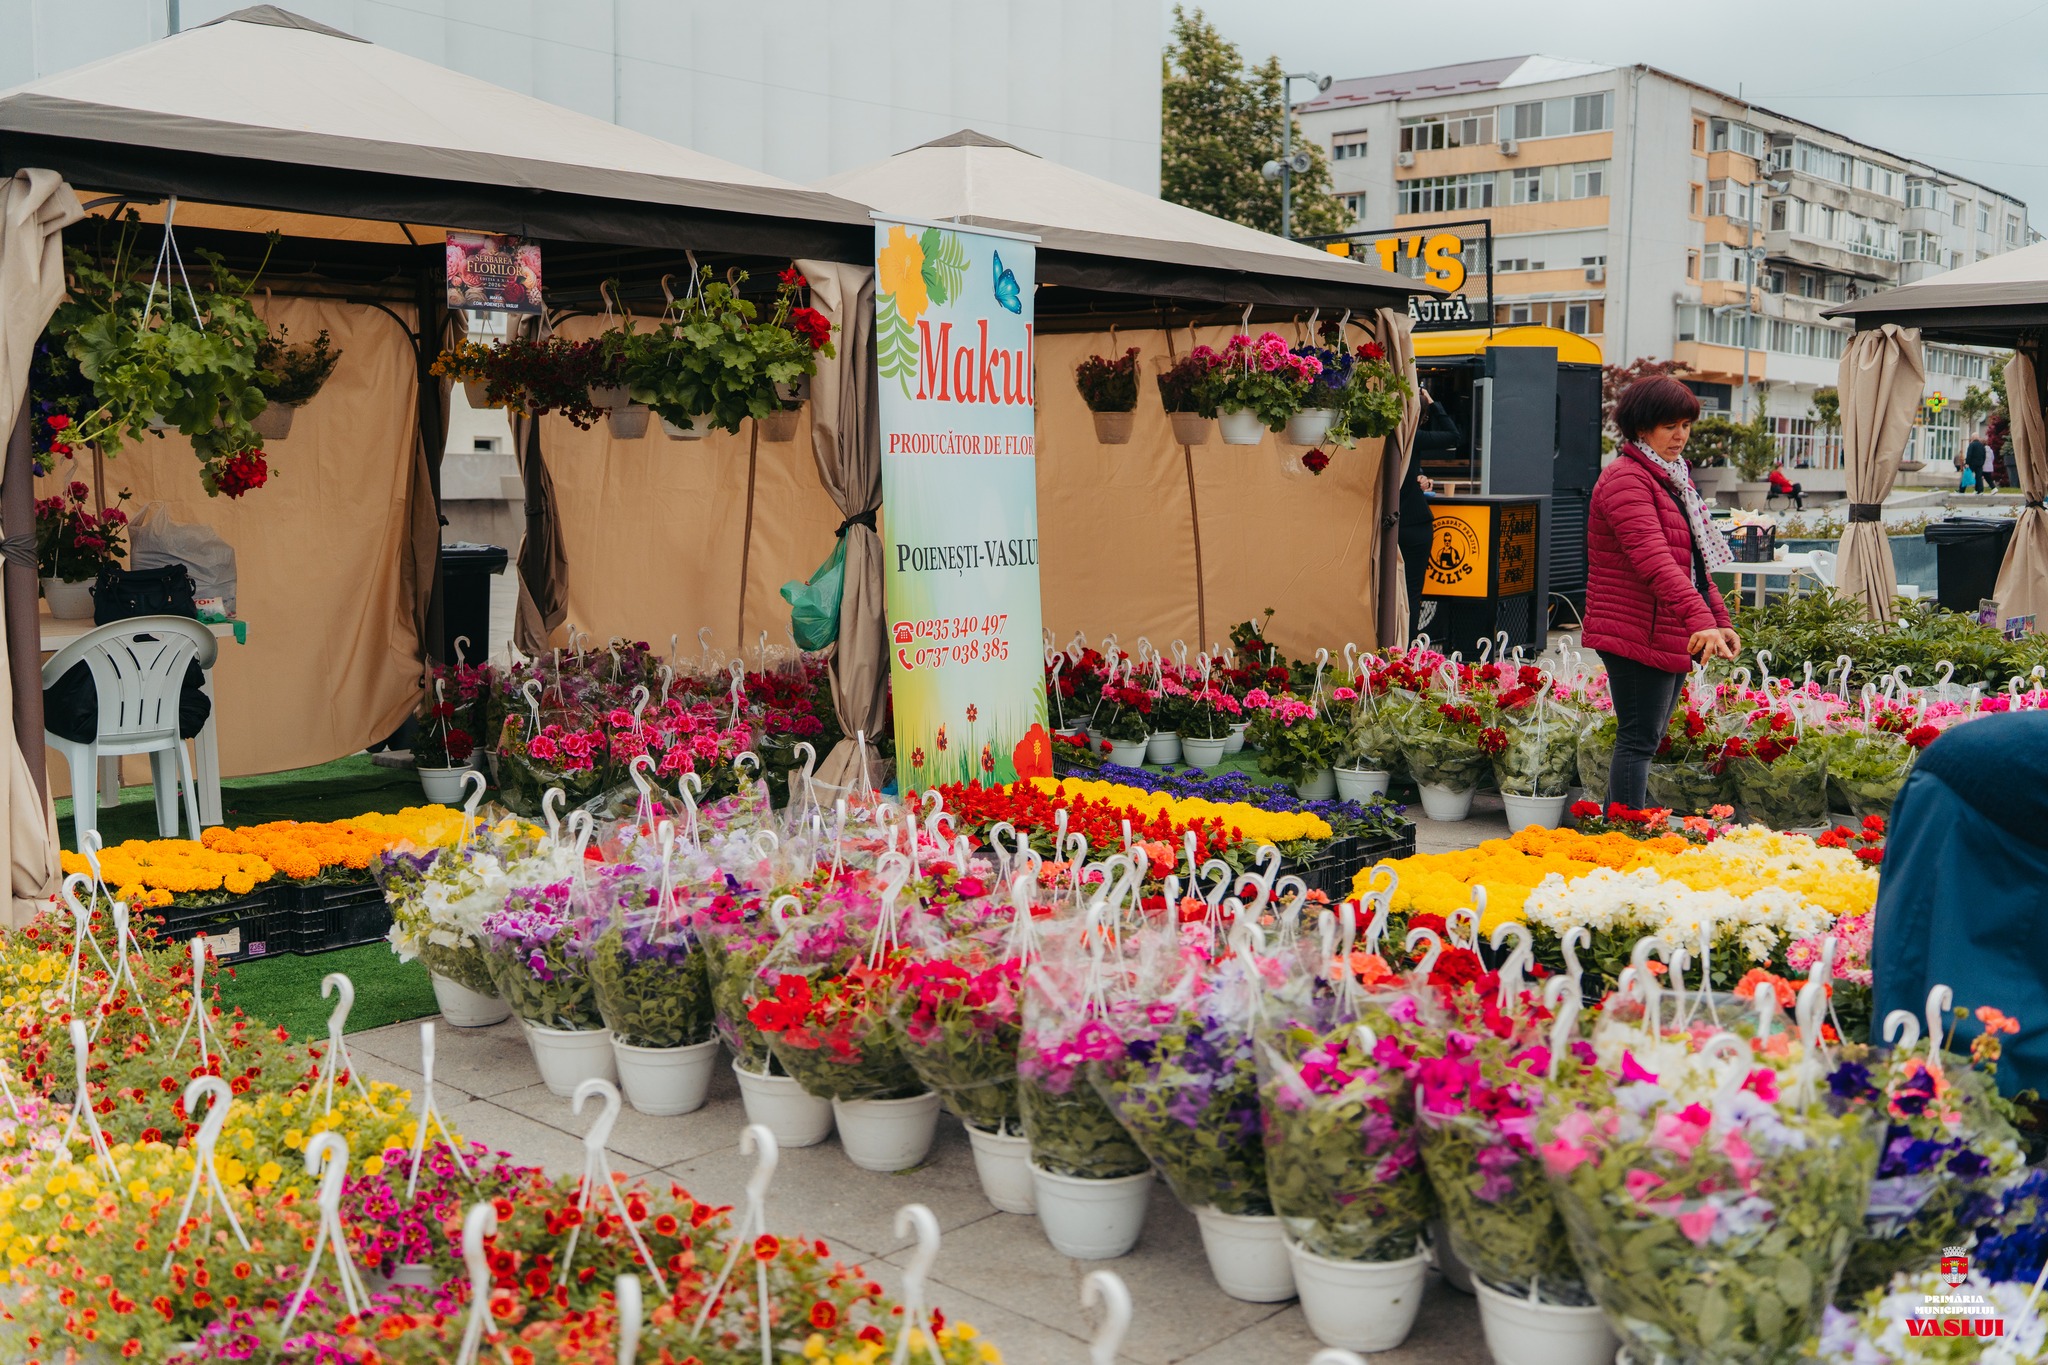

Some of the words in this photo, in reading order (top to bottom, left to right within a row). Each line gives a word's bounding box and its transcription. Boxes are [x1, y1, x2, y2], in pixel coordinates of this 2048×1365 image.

[467, 261, 522, 276] FLORILOR
[475, 254, 512, 265] SERBAREA
[916, 319, 1034, 407] Makul
[889, 429, 981, 455] PRODUCĂTOR
[984, 435, 1002, 455] DE
[1005, 436, 1035, 456] FLOR
[915, 618, 950, 641] 0235
[952, 615, 978, 639] 340
[981, 614, 1008, 637] 497
[915, 646, 950, 670] 0737
[952, 639, 979, 665] 038
[981, 637, 1009, 662] 385
